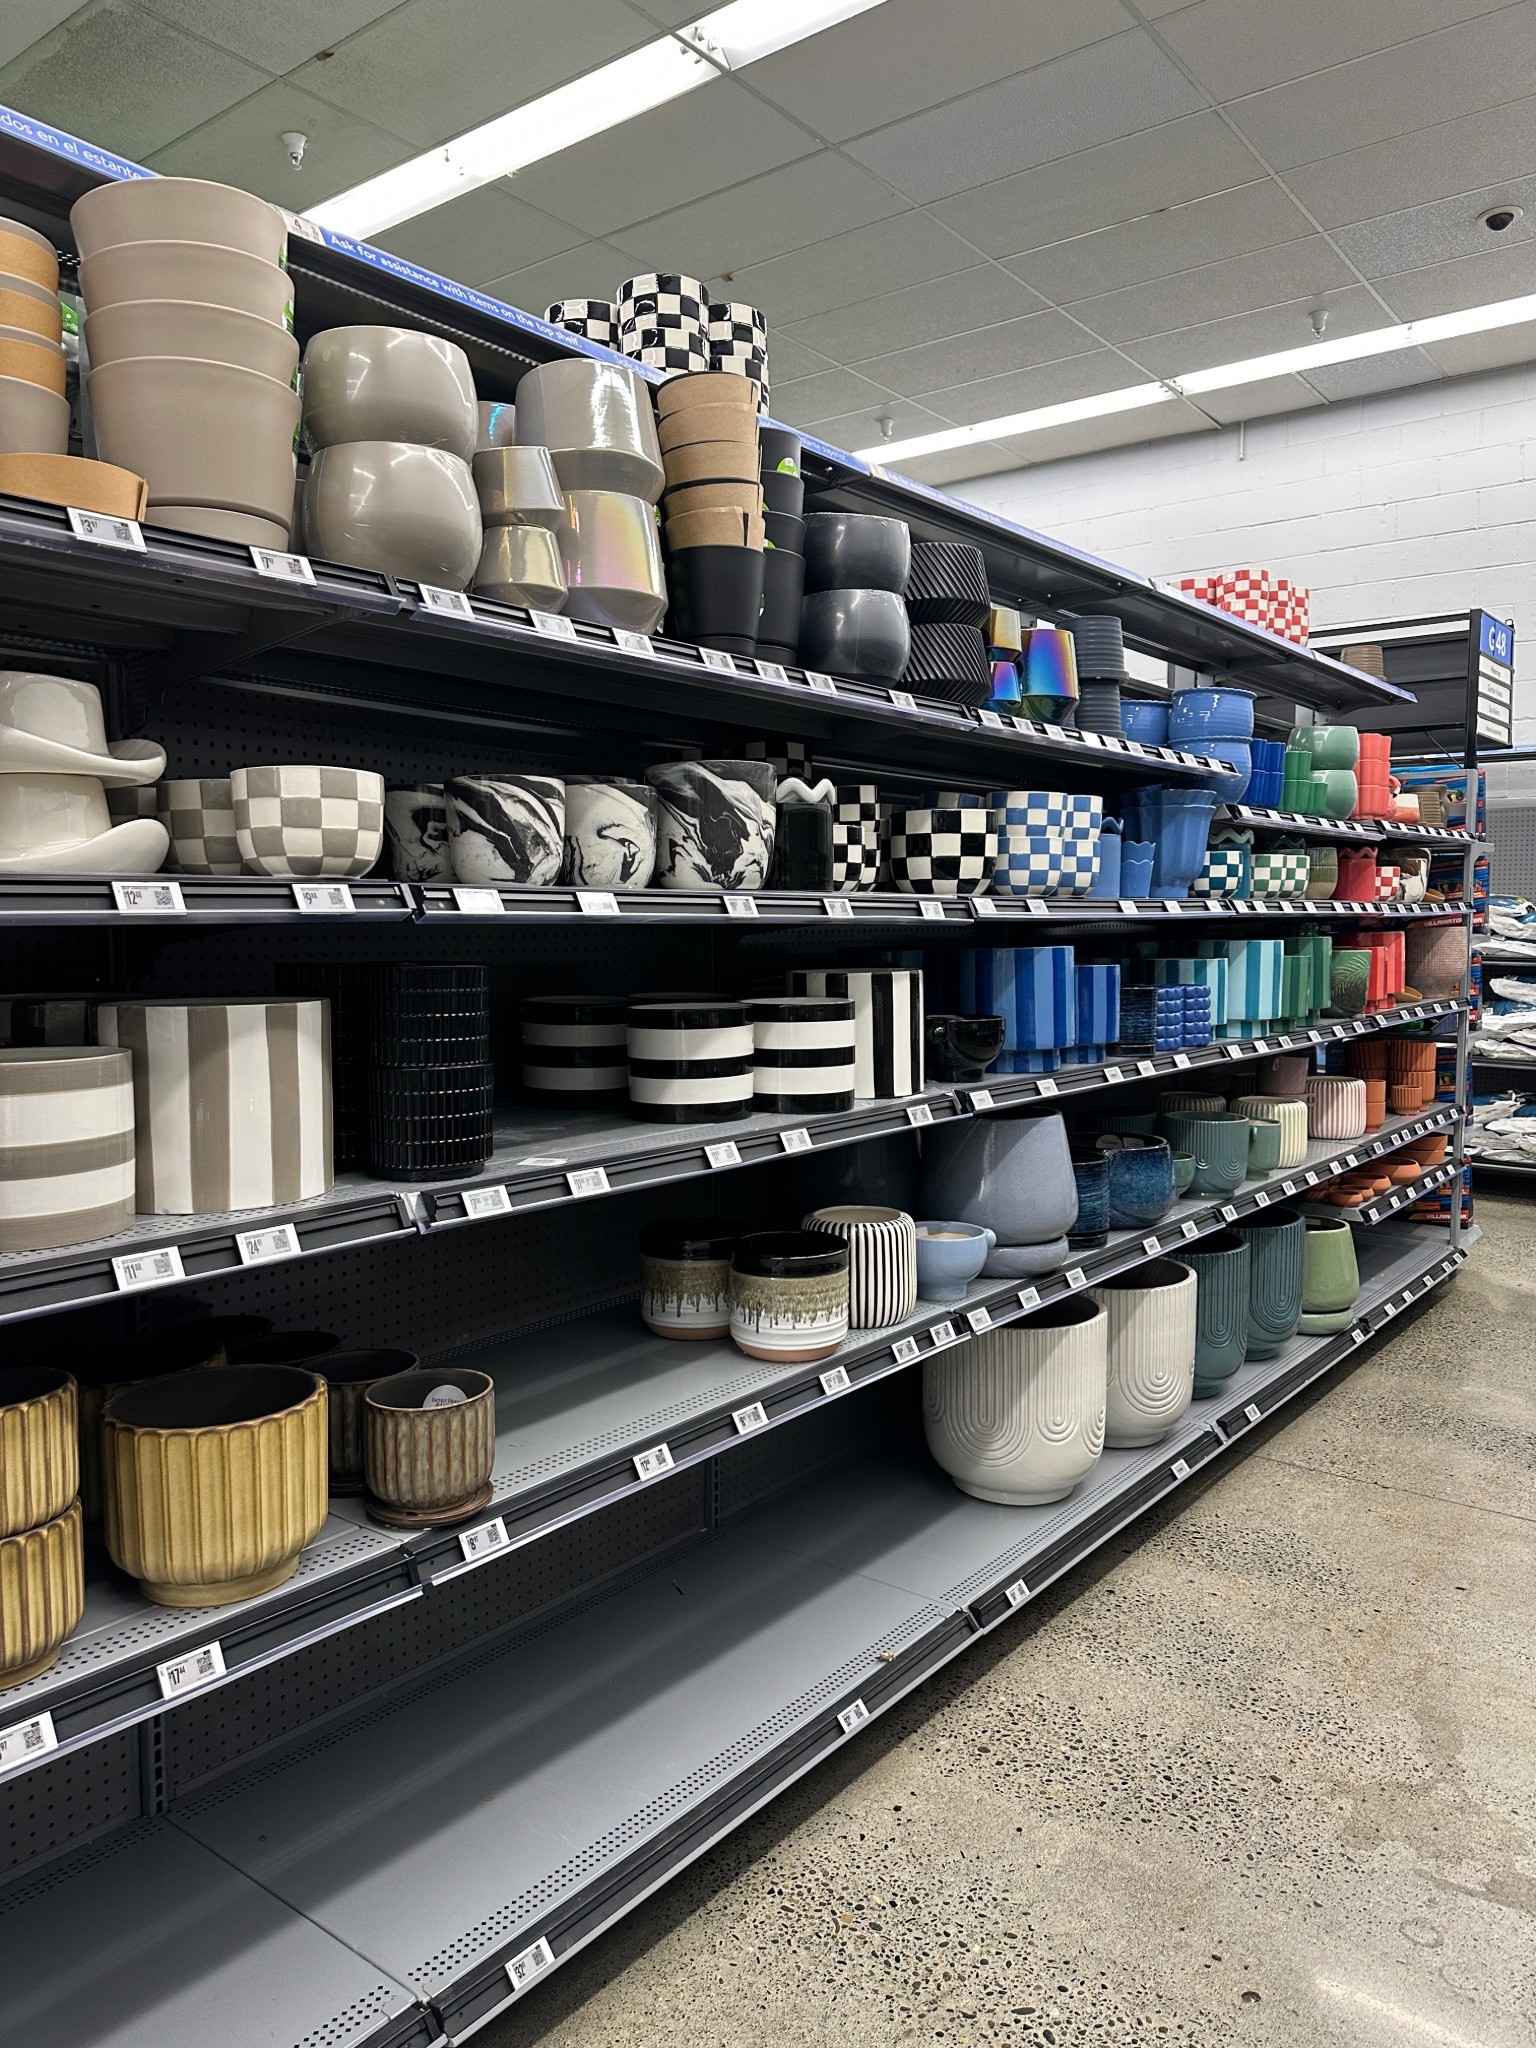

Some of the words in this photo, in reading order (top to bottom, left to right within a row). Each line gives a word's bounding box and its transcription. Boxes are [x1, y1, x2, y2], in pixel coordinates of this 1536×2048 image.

[37, 130, 60, 147] en
[63, 141, 79, 155] el
[331, 234, 357, 253] Ask
[357, 244, 377, 261] for
[380, 256, 440, 288] assistance
[441, 282, 467, 300] with
[467, 292, 499, 313] items
[502, 308, 515, 319] on
[516, 312, 535, 328] the
[535, 322, 554, 337] top
[555, 330, 583, 348] shelf.
